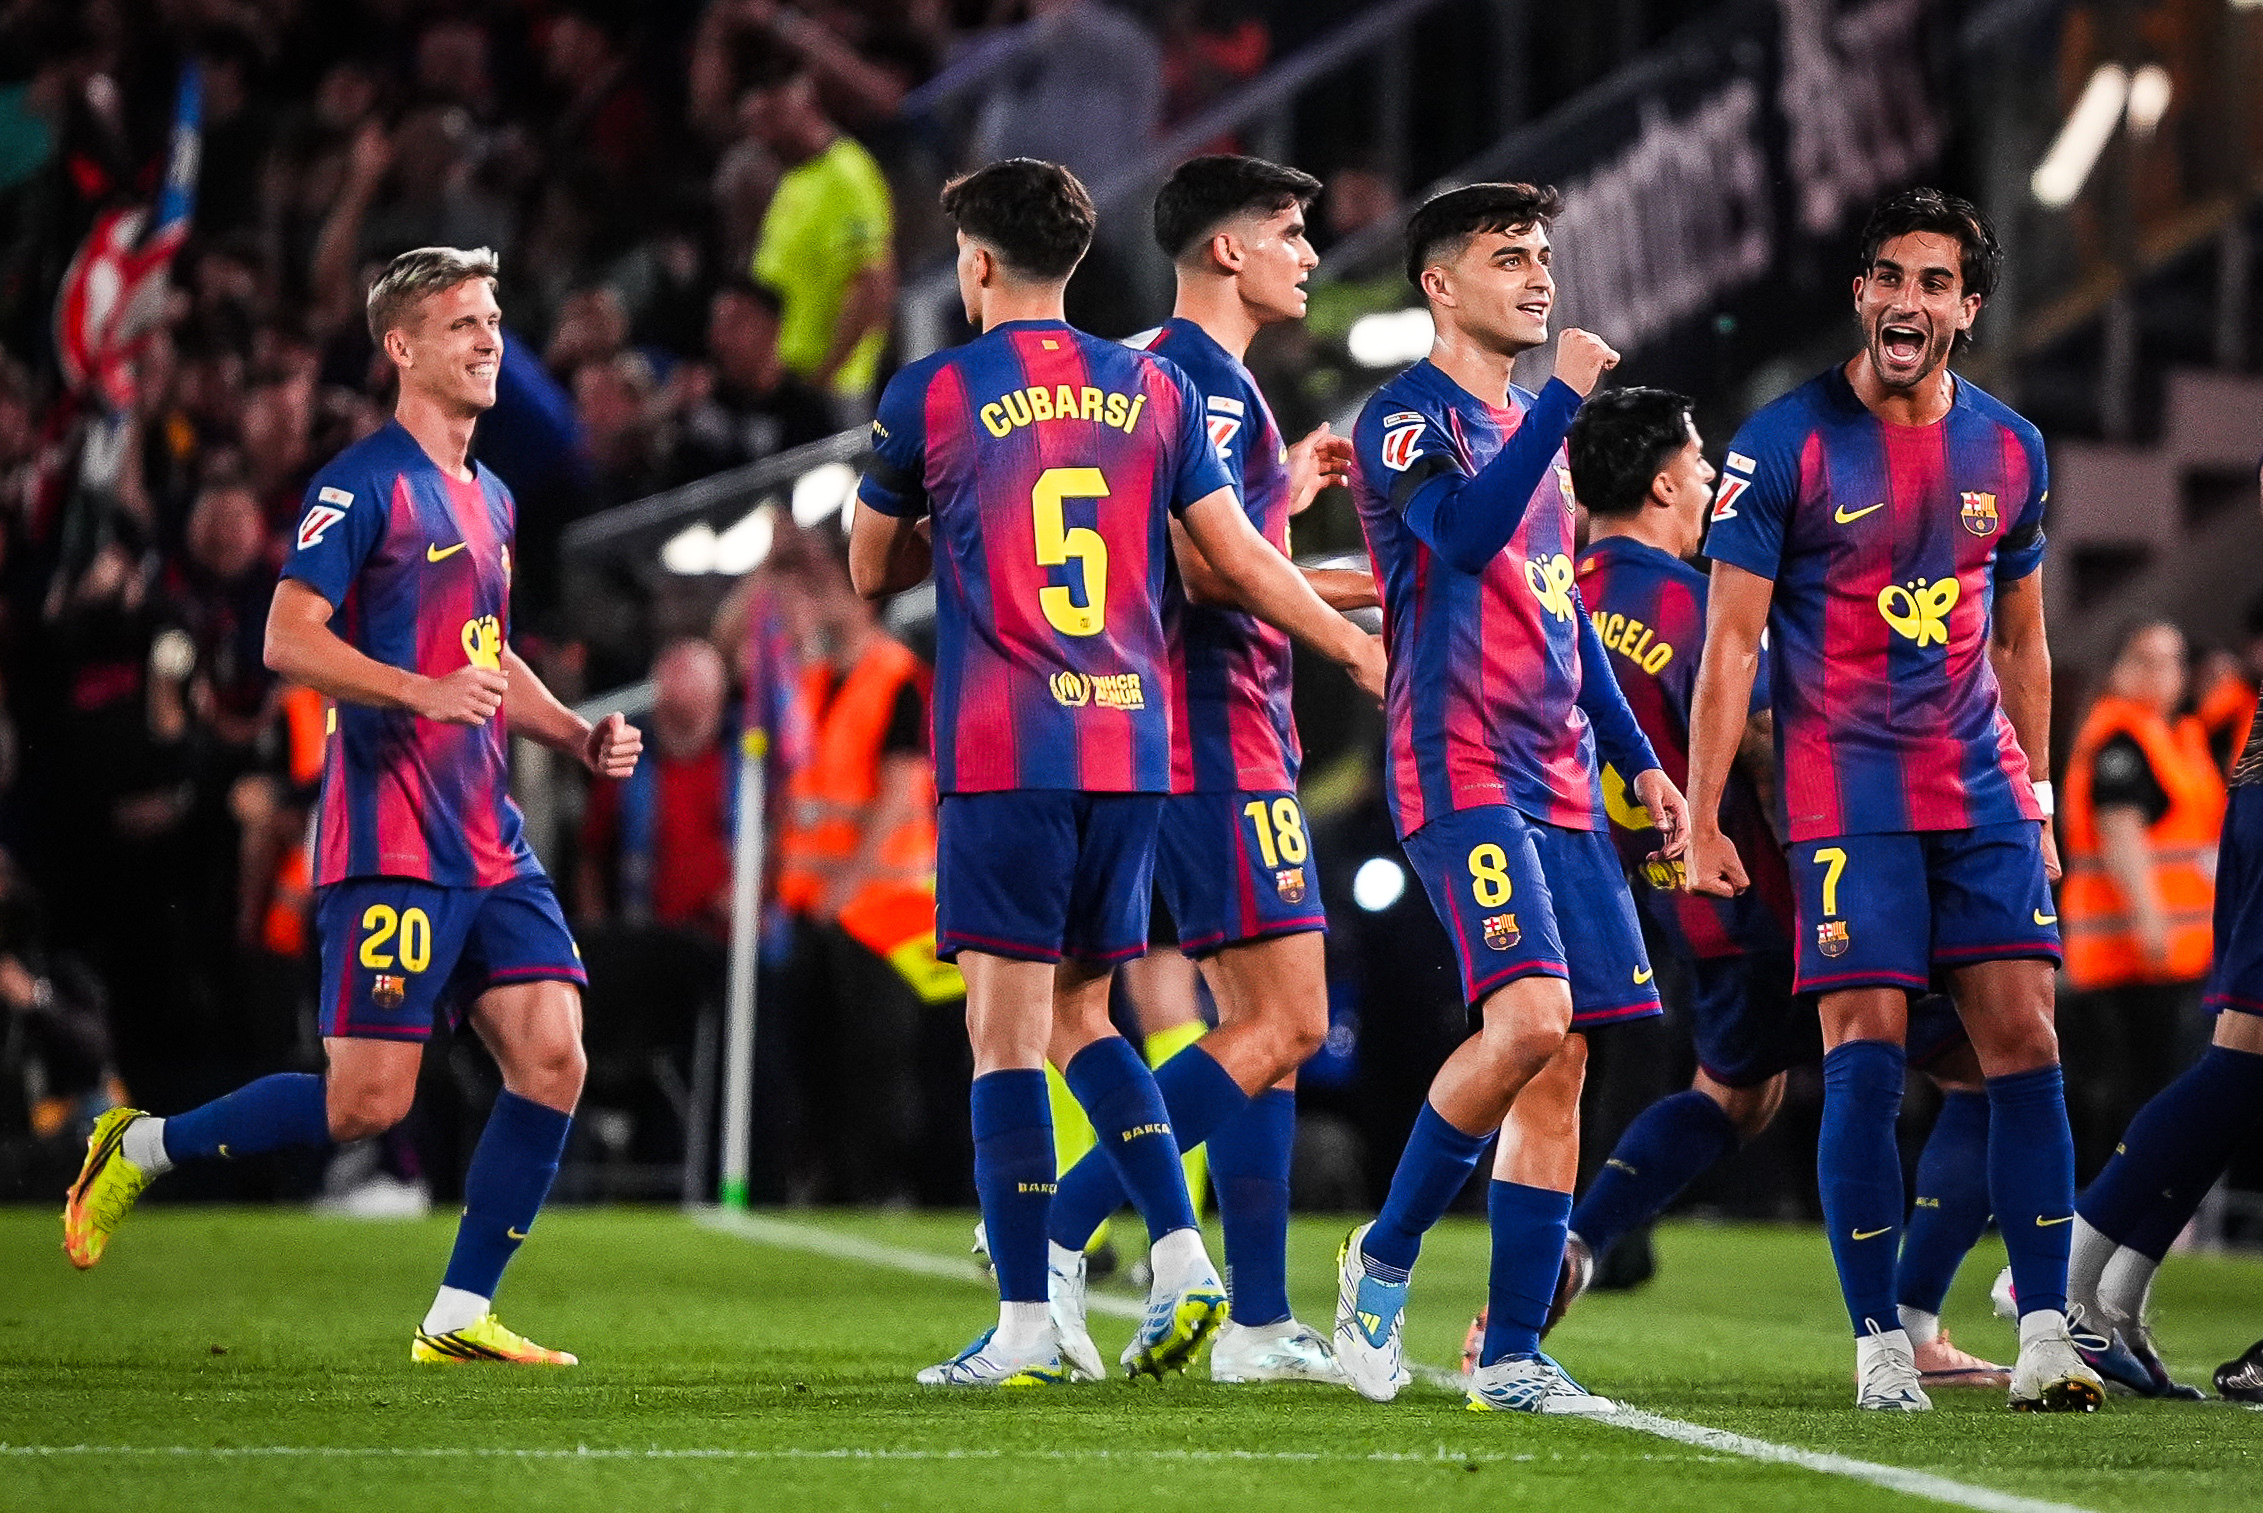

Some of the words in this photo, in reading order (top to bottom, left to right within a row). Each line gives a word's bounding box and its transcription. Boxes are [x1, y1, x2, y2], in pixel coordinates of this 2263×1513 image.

[980, 384, 1147, 438] CUBARSÍ
[1032, 467, 1110, 636] 5
[1243, 797, 1307, 869] 18
[1468, 843, 1512, 908] 8
[1814, 847, 1847, 916] 7
[360, 904, 431, 974] 20
